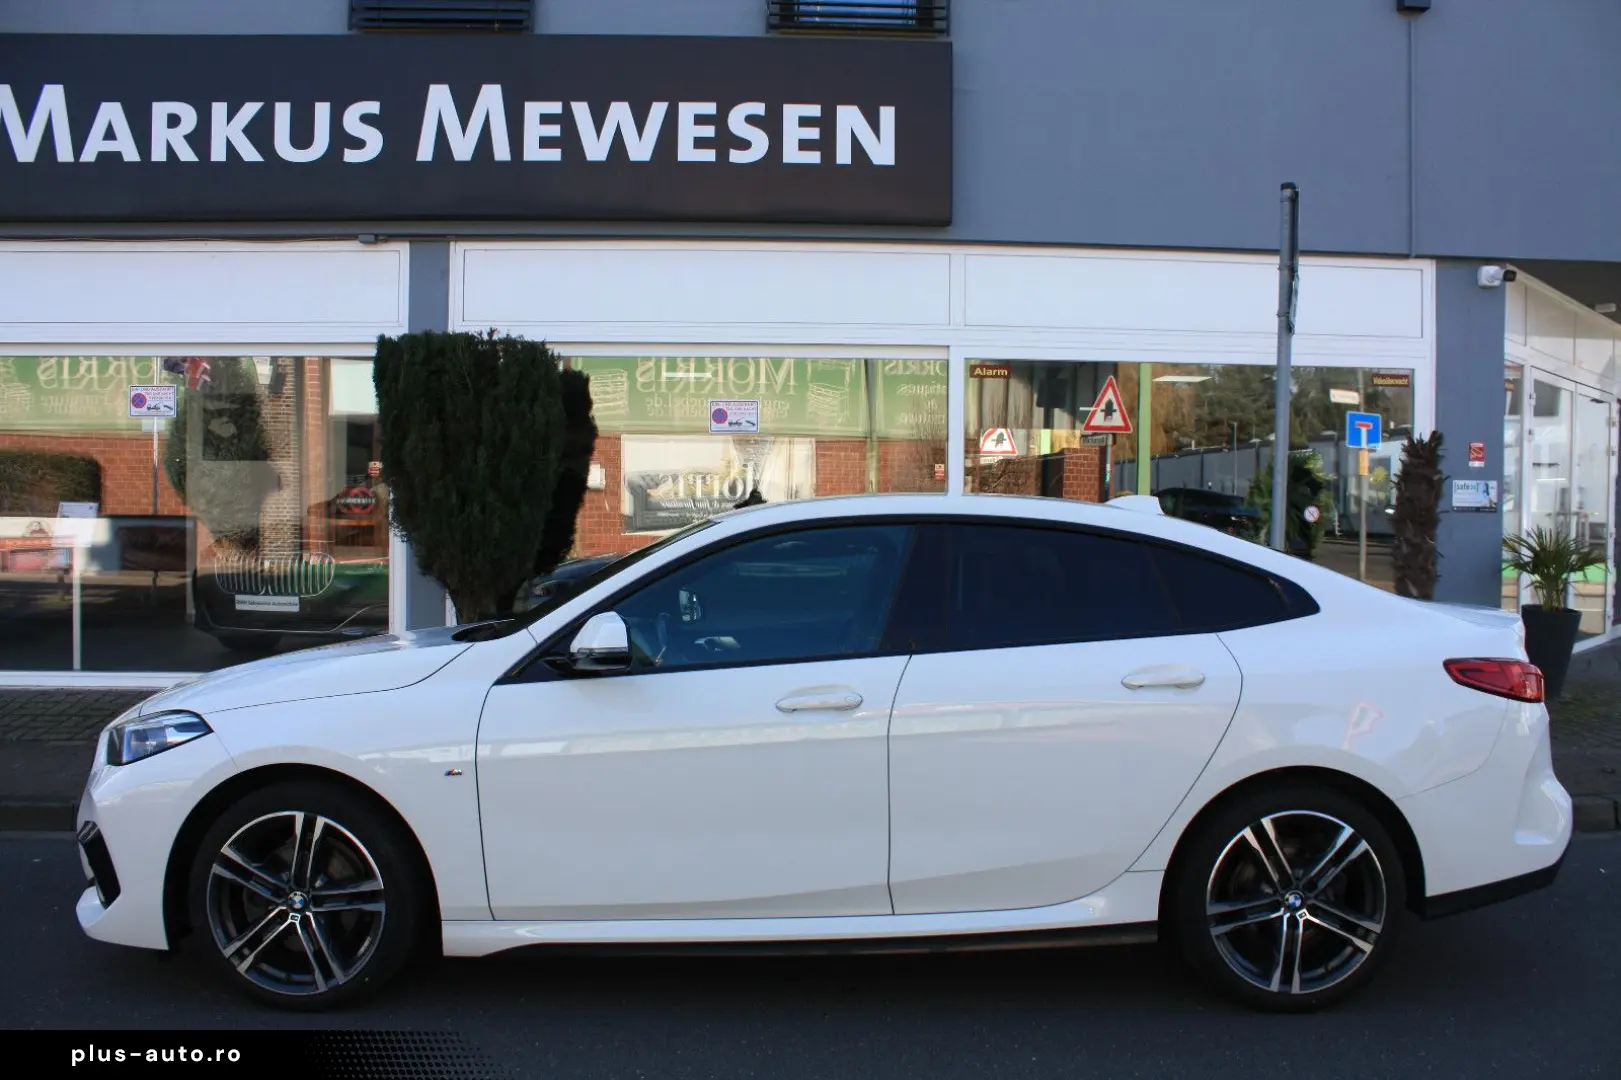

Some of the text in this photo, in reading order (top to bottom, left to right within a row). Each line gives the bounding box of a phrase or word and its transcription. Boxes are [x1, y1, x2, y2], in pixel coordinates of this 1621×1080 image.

[0, 83, 897, 167] MARKUS MEWESEN
[974, 367, 1008, 376] Alarm
